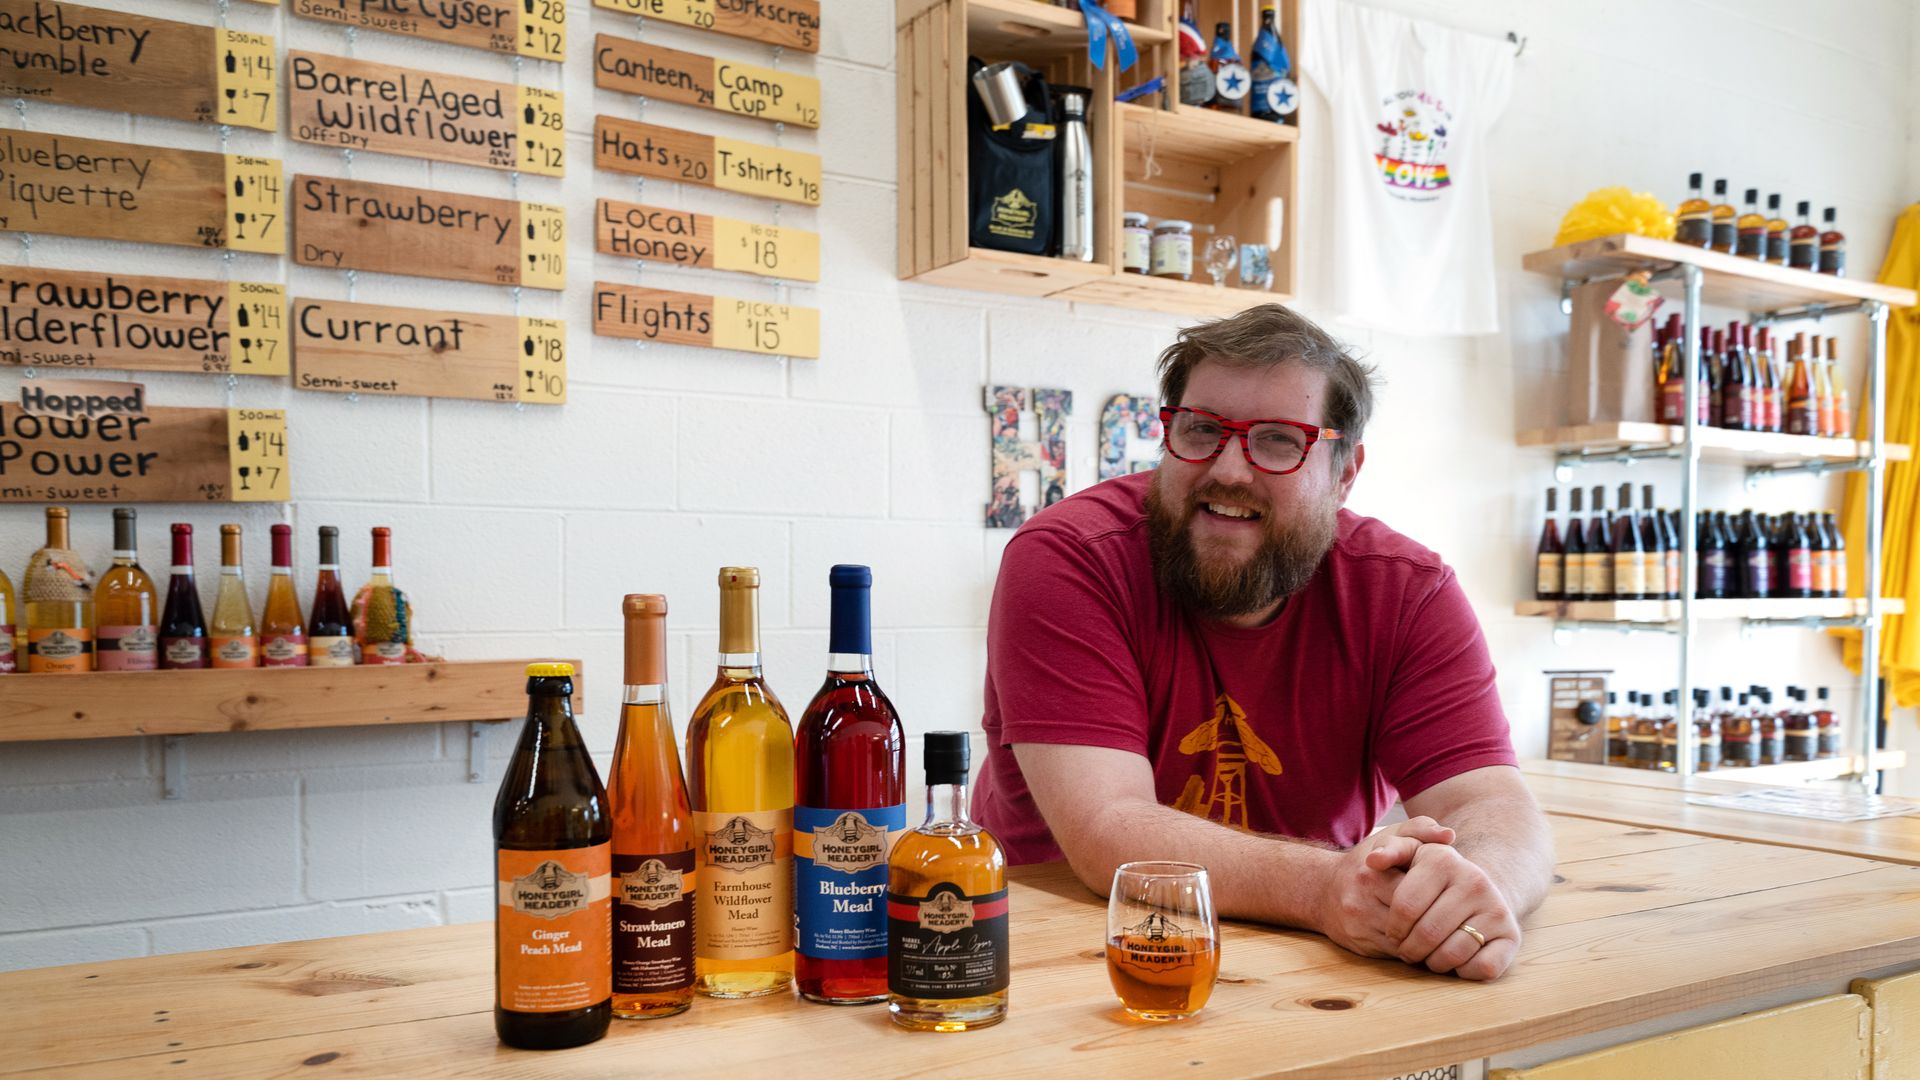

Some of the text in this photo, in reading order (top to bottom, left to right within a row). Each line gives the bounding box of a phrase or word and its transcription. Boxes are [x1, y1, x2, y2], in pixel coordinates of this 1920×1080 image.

[687, 6, 715, 29] $20
[539, 26, 562, 54] $12
[796, 29, 812, 47] $5
[242, 56, 273, 80] $14
[599, 48, 715, 104] Canteen $24
[294, 57, 503, 120] Barrel Aged
[718, 65, 784, 106] Camp
[243, 89, 270, 123] $7
[538, 103, 563, 131] $28
[729, 92, 817, 124] Cup $12
[317, 99, 517, 149] Wildflower
[300, 125, 369, 149] Off-Dry
[0, 136, 151, 190] lueberry
[539, 141, 562, 167] $12
[601, 130, 707, 180] Hats $20
[718, 150, 820, 201] T-shirts $18
[249, 176, 280, 204] $14
[303, 180, 512, 245] Strawberry
[604, 202, 696, 237] Local
[251, 213, 276, 238] $7
[542, 217, 562, 242] $18
[304, 244, 344, 265] Dry
[611, 228, 706, 264] Honey
[741, 237, 778, 269] $18
[541, 252, 562, 275] $10
[0, 277, 223, 328] rawberry
[736, 301, 789, 320] PICK 4
[253, 304, 280, 329] $14
[301, 304, 463, 350] Currant
[597, 292, 710, 338] Flights
[2, 305, 230, 352] lderflower
[747, 319, 780, 350] $15
[256, 338, 278, 361] $7
[538, 335, 563, 362] $18
[538, 370, 563, 397] $10
[21, 387, 143, 418] Hopped
[255, 432, 284, 456] $14
[0, 441, 158, 477] Power
[256, 467, 280, 489] $7
[709, 844, 771, 854] HONEYGIRL
[714, 854, 767, 864] MEADERY
[822, 844, 882, 853] HONEYGIRL
[828, 854, 878, 863] MEADERY
[518, 889, 584, 900] HONEYGIRL
[625, 884, 679, 893] HONEYGIRL
[630, 891, 676, 901] MEADERY
[714, 881, 772, 892] Farmhouse
[820, 880, 886, 897] Blueberry
[524, 899, 579, 910] MEADERY
[714, 895, 772, 906] Wildflower
[833, 899, 873, 912] Mead
[620, 920, 686, 932] Strawbanero
[728, 910, 759, 920] Mead
[520, 941, 582, 955] Peach Mead
[532, 930, 570, 942] Ginger
[637, 935, 671, 949] Mead
[1127, 942, 1187, 953] HONEYGIRL
[1131, 953, 1183, 964] MEADERY
